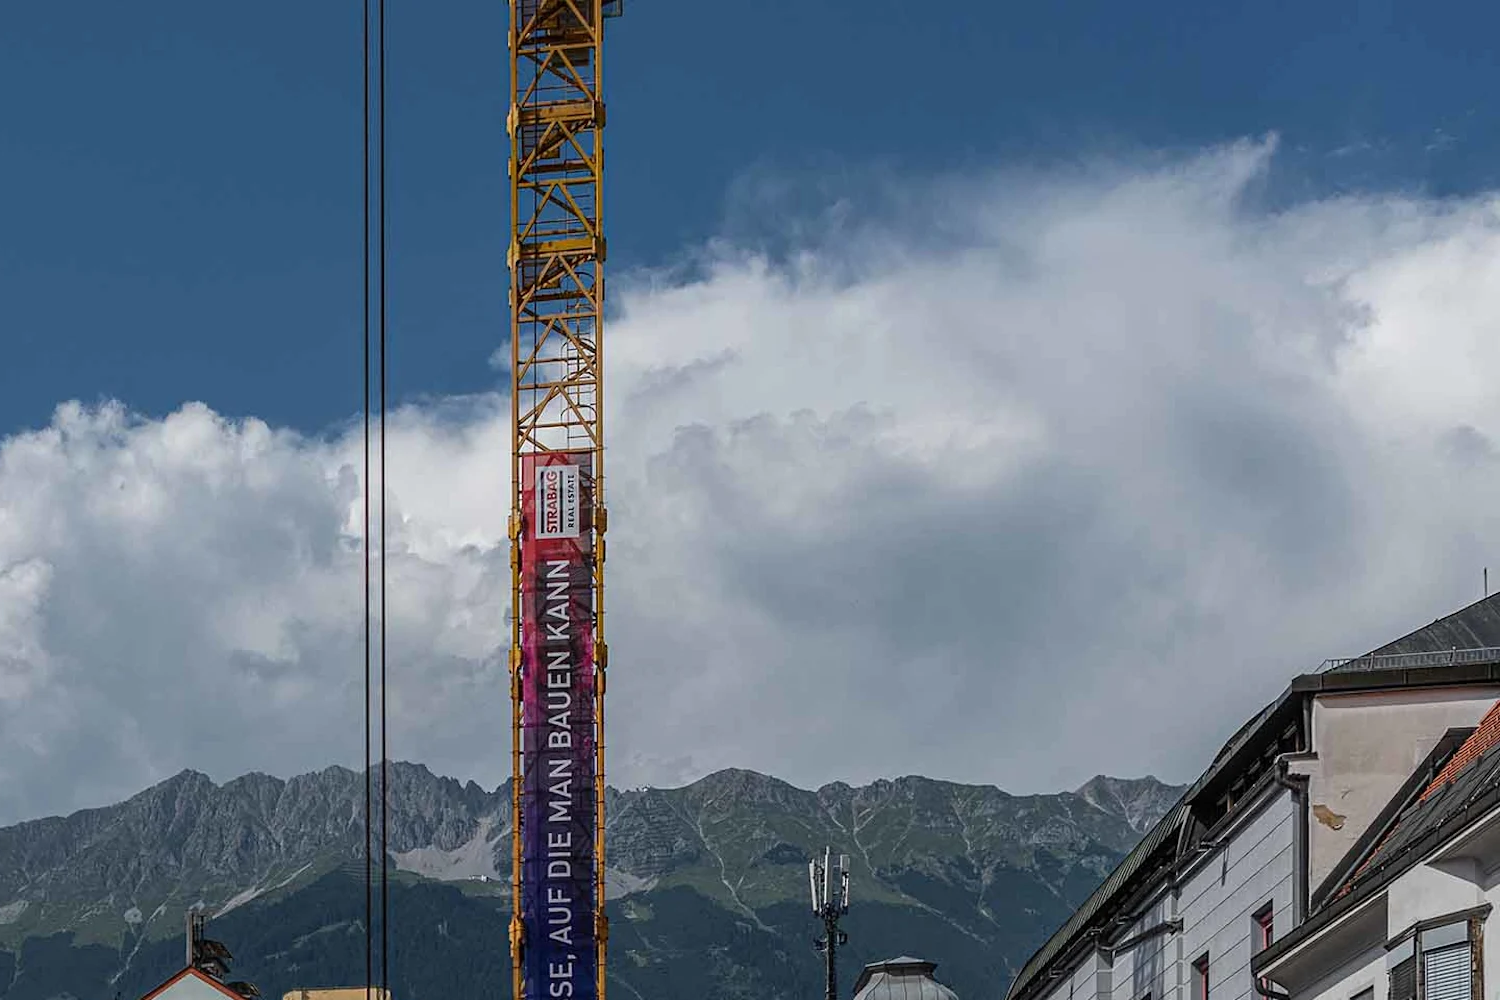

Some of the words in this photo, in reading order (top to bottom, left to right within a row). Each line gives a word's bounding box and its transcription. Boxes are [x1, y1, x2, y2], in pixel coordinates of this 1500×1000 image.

[546, 470, 558, 534] STRABAG
[567, 474, 575, 504] ESTATE
[567, 507, 575, 528] REAL
[546, 559, 571, 640] KANN
[547, 651, 572, 749] BAUEN
[548, 759, 573, 822] MAN
[548, 832, 572, 878] DIE
[548, 890, 573, 945] AUF
